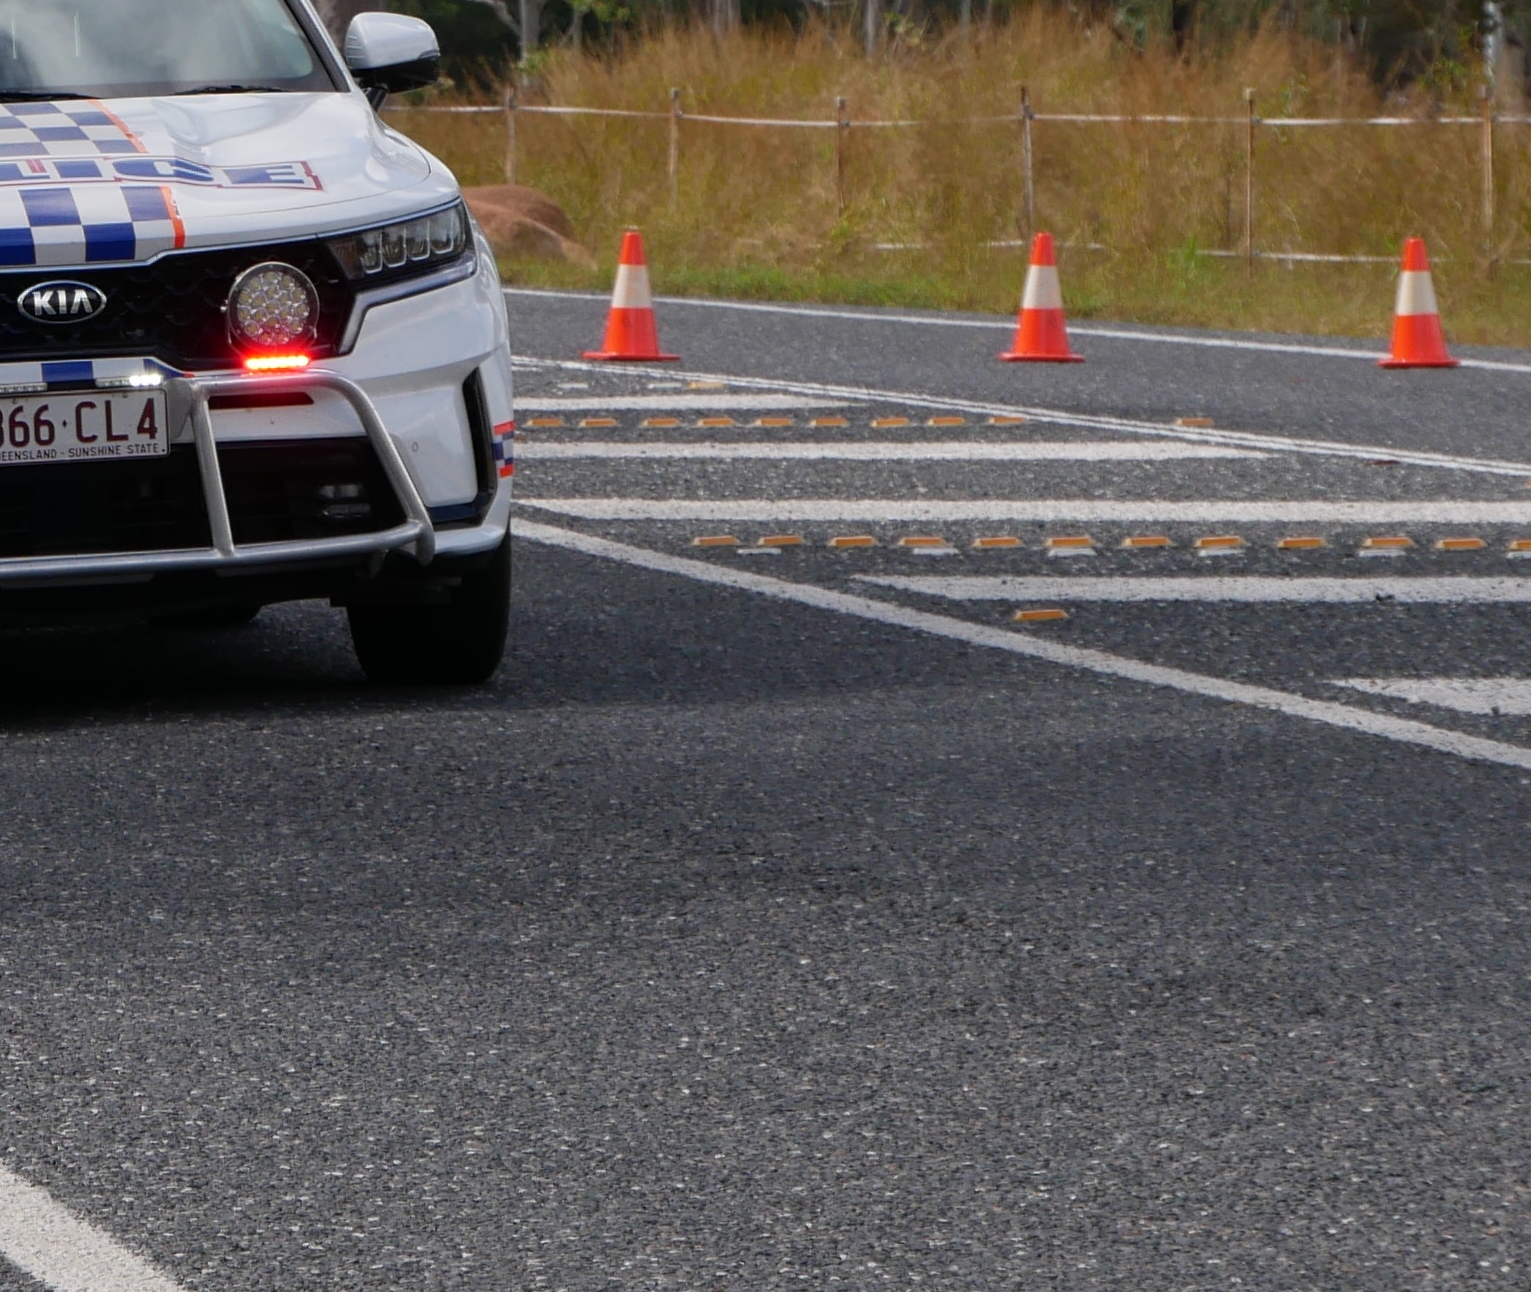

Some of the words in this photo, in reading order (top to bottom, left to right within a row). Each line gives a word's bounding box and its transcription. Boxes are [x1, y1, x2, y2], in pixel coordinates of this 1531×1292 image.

[32, 289, 93, 316] KIA
[68, 444, 122, 458] SUNSHINE
[127, 442, 159, 454] STATE
